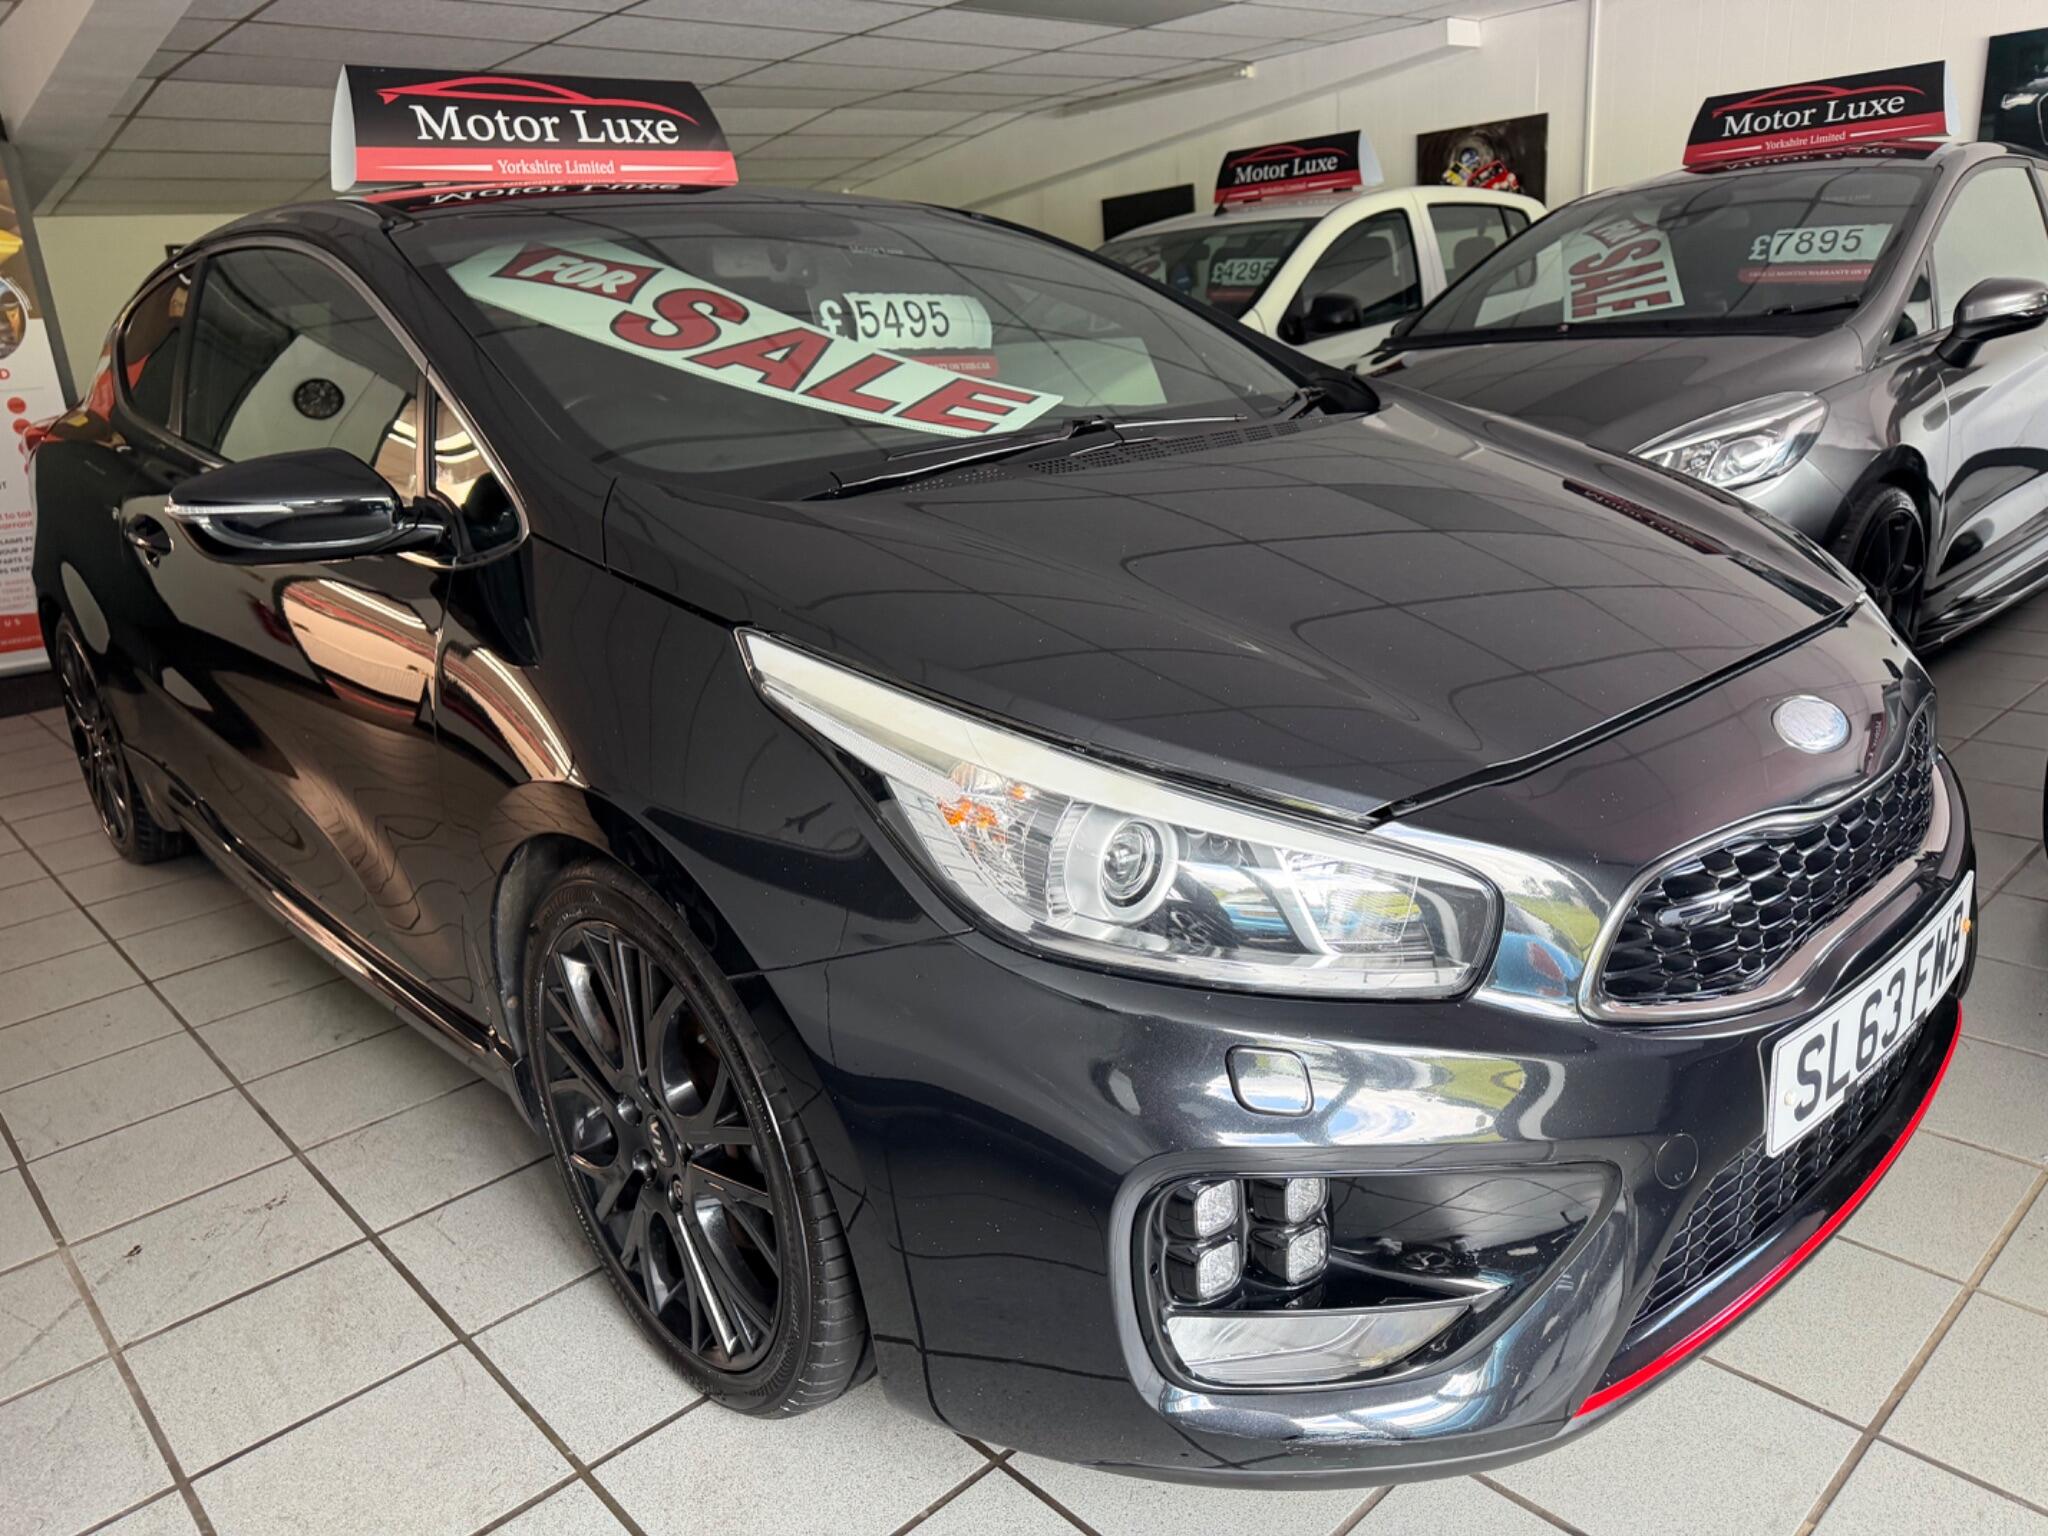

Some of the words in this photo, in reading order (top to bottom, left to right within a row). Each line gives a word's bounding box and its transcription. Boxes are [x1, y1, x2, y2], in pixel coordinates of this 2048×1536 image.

[408, 104, 560, 142] Motor
[570, 108, 680, 145] Luxe
[1721, 108, 1816, 137] Motor
[1825, 94, 1906, 122] Luxe
[1764, 137, 1808, 151] Yorkshire
[1809, 131, 1847, 145] Limited
[497, 159, 563, 175] Yorkshire
[565, 159, 616, 175] Limited
[1233, 163, 1288, 184] Motor
[1292, 156, 1339, 176] Luxe
[1748, 229, 1864, 260] £7895
[818, 299, 950, 340] £5495
[516, 254, 639, 296] FOR
[609, 287, 1042, 434] SALE
[1793, 966, 1906, 1122] SL63
